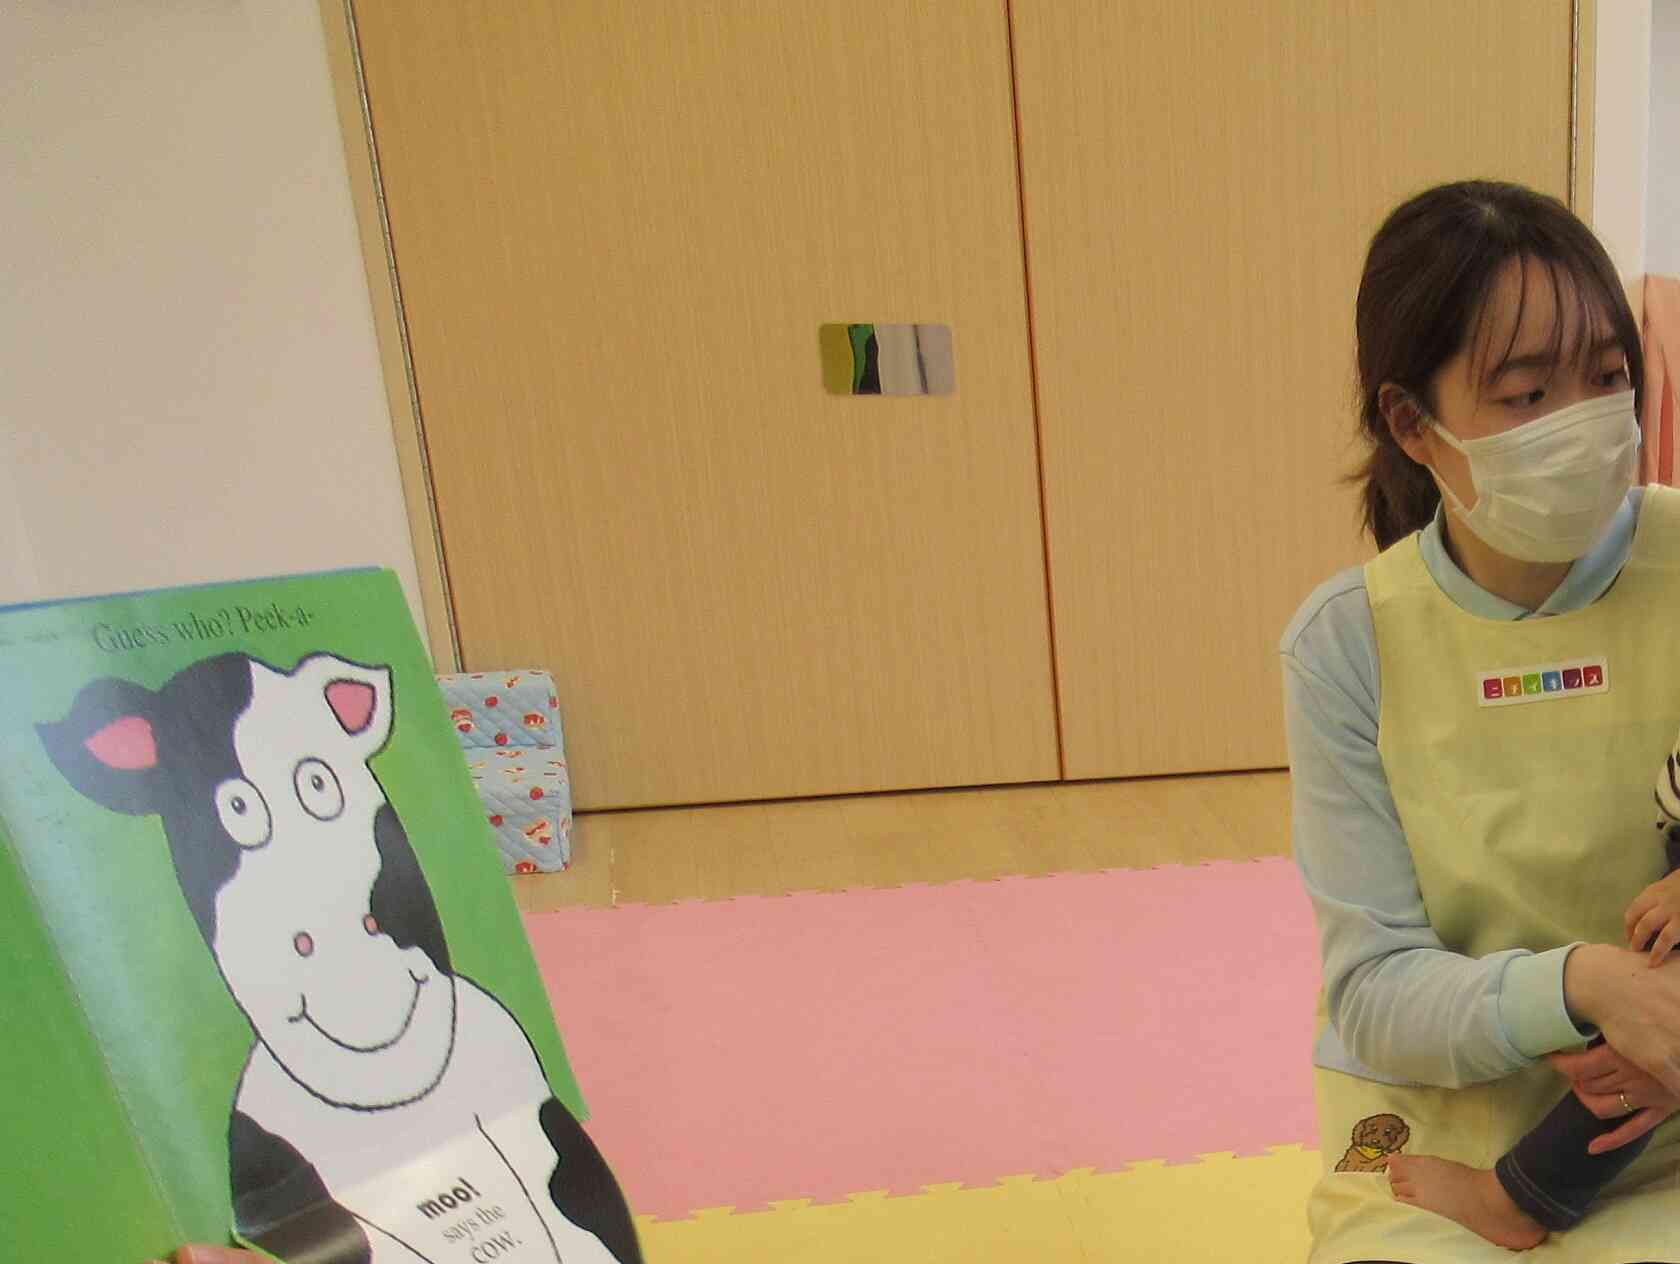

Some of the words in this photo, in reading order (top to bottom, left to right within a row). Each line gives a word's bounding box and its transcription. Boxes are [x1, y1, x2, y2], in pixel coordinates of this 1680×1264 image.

[94, 621, 170, 654] Guess
[172, 608, 235, 642] who?
[416, 1176, 482, 1220] moo!
[442, 1218, 479, 1242] says
[475, 1206, 505, 1225] the
